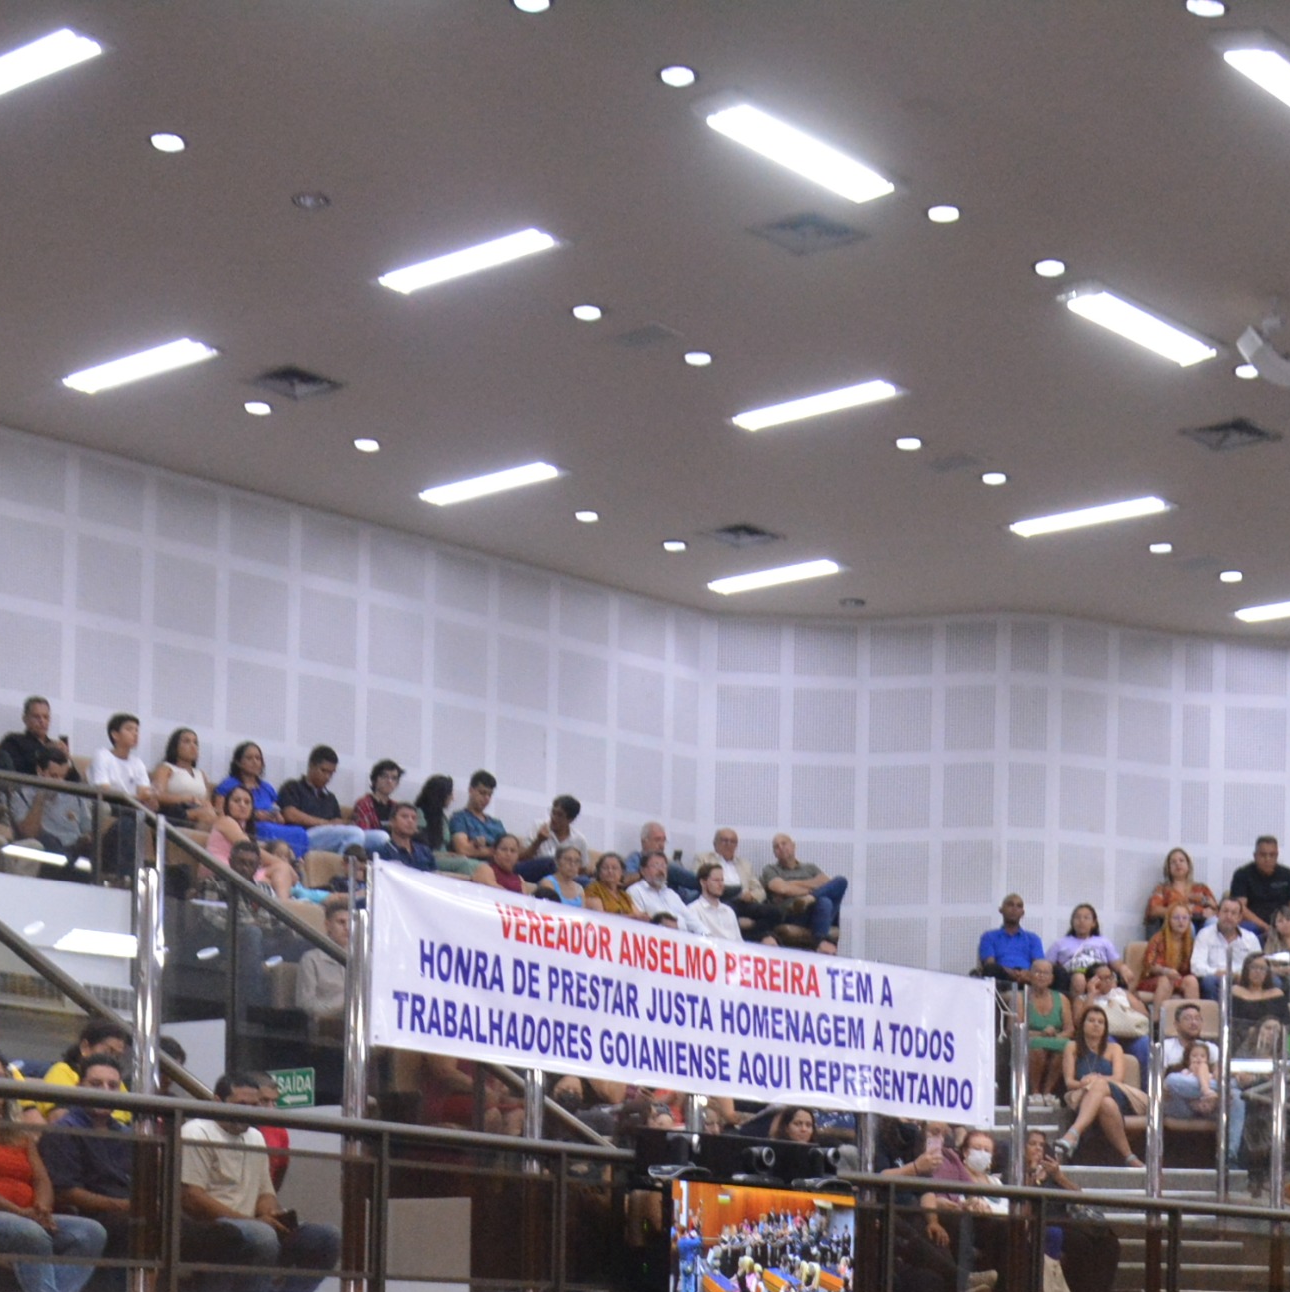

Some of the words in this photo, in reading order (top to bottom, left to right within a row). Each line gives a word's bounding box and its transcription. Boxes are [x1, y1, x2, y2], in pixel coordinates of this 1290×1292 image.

[419, 938, 505, 993] HONRA
[512, 957, 540, 1000] DE
[547, 965, 640, 1019] PRESTAR
[645, 986, 714, 1032] JUSTA
[720, 999, 865, 1050] HOMENAGEM
[872, 1019, 884, 1053] A
[888, 1022, 955, 1063] TODOS
[495, 902, 614, 963] VEREADOR
[618, 931, 718, 982] ANSELMO
[724, 951, 821, 998] PEREIRA
[826, 966, 874, 1004] TEM
[880, 974, 893, 1008] A
[277, 1072, 313, 1094] SAÍDA
[393, 989, 593, 1062] TRABALHADORES
[599, 1028, 731, 1082] GOIANIENSE
[738, 1050, 791, 1089] AQUI
[799, 1057, 974, 1111] REPRESENTANDO
